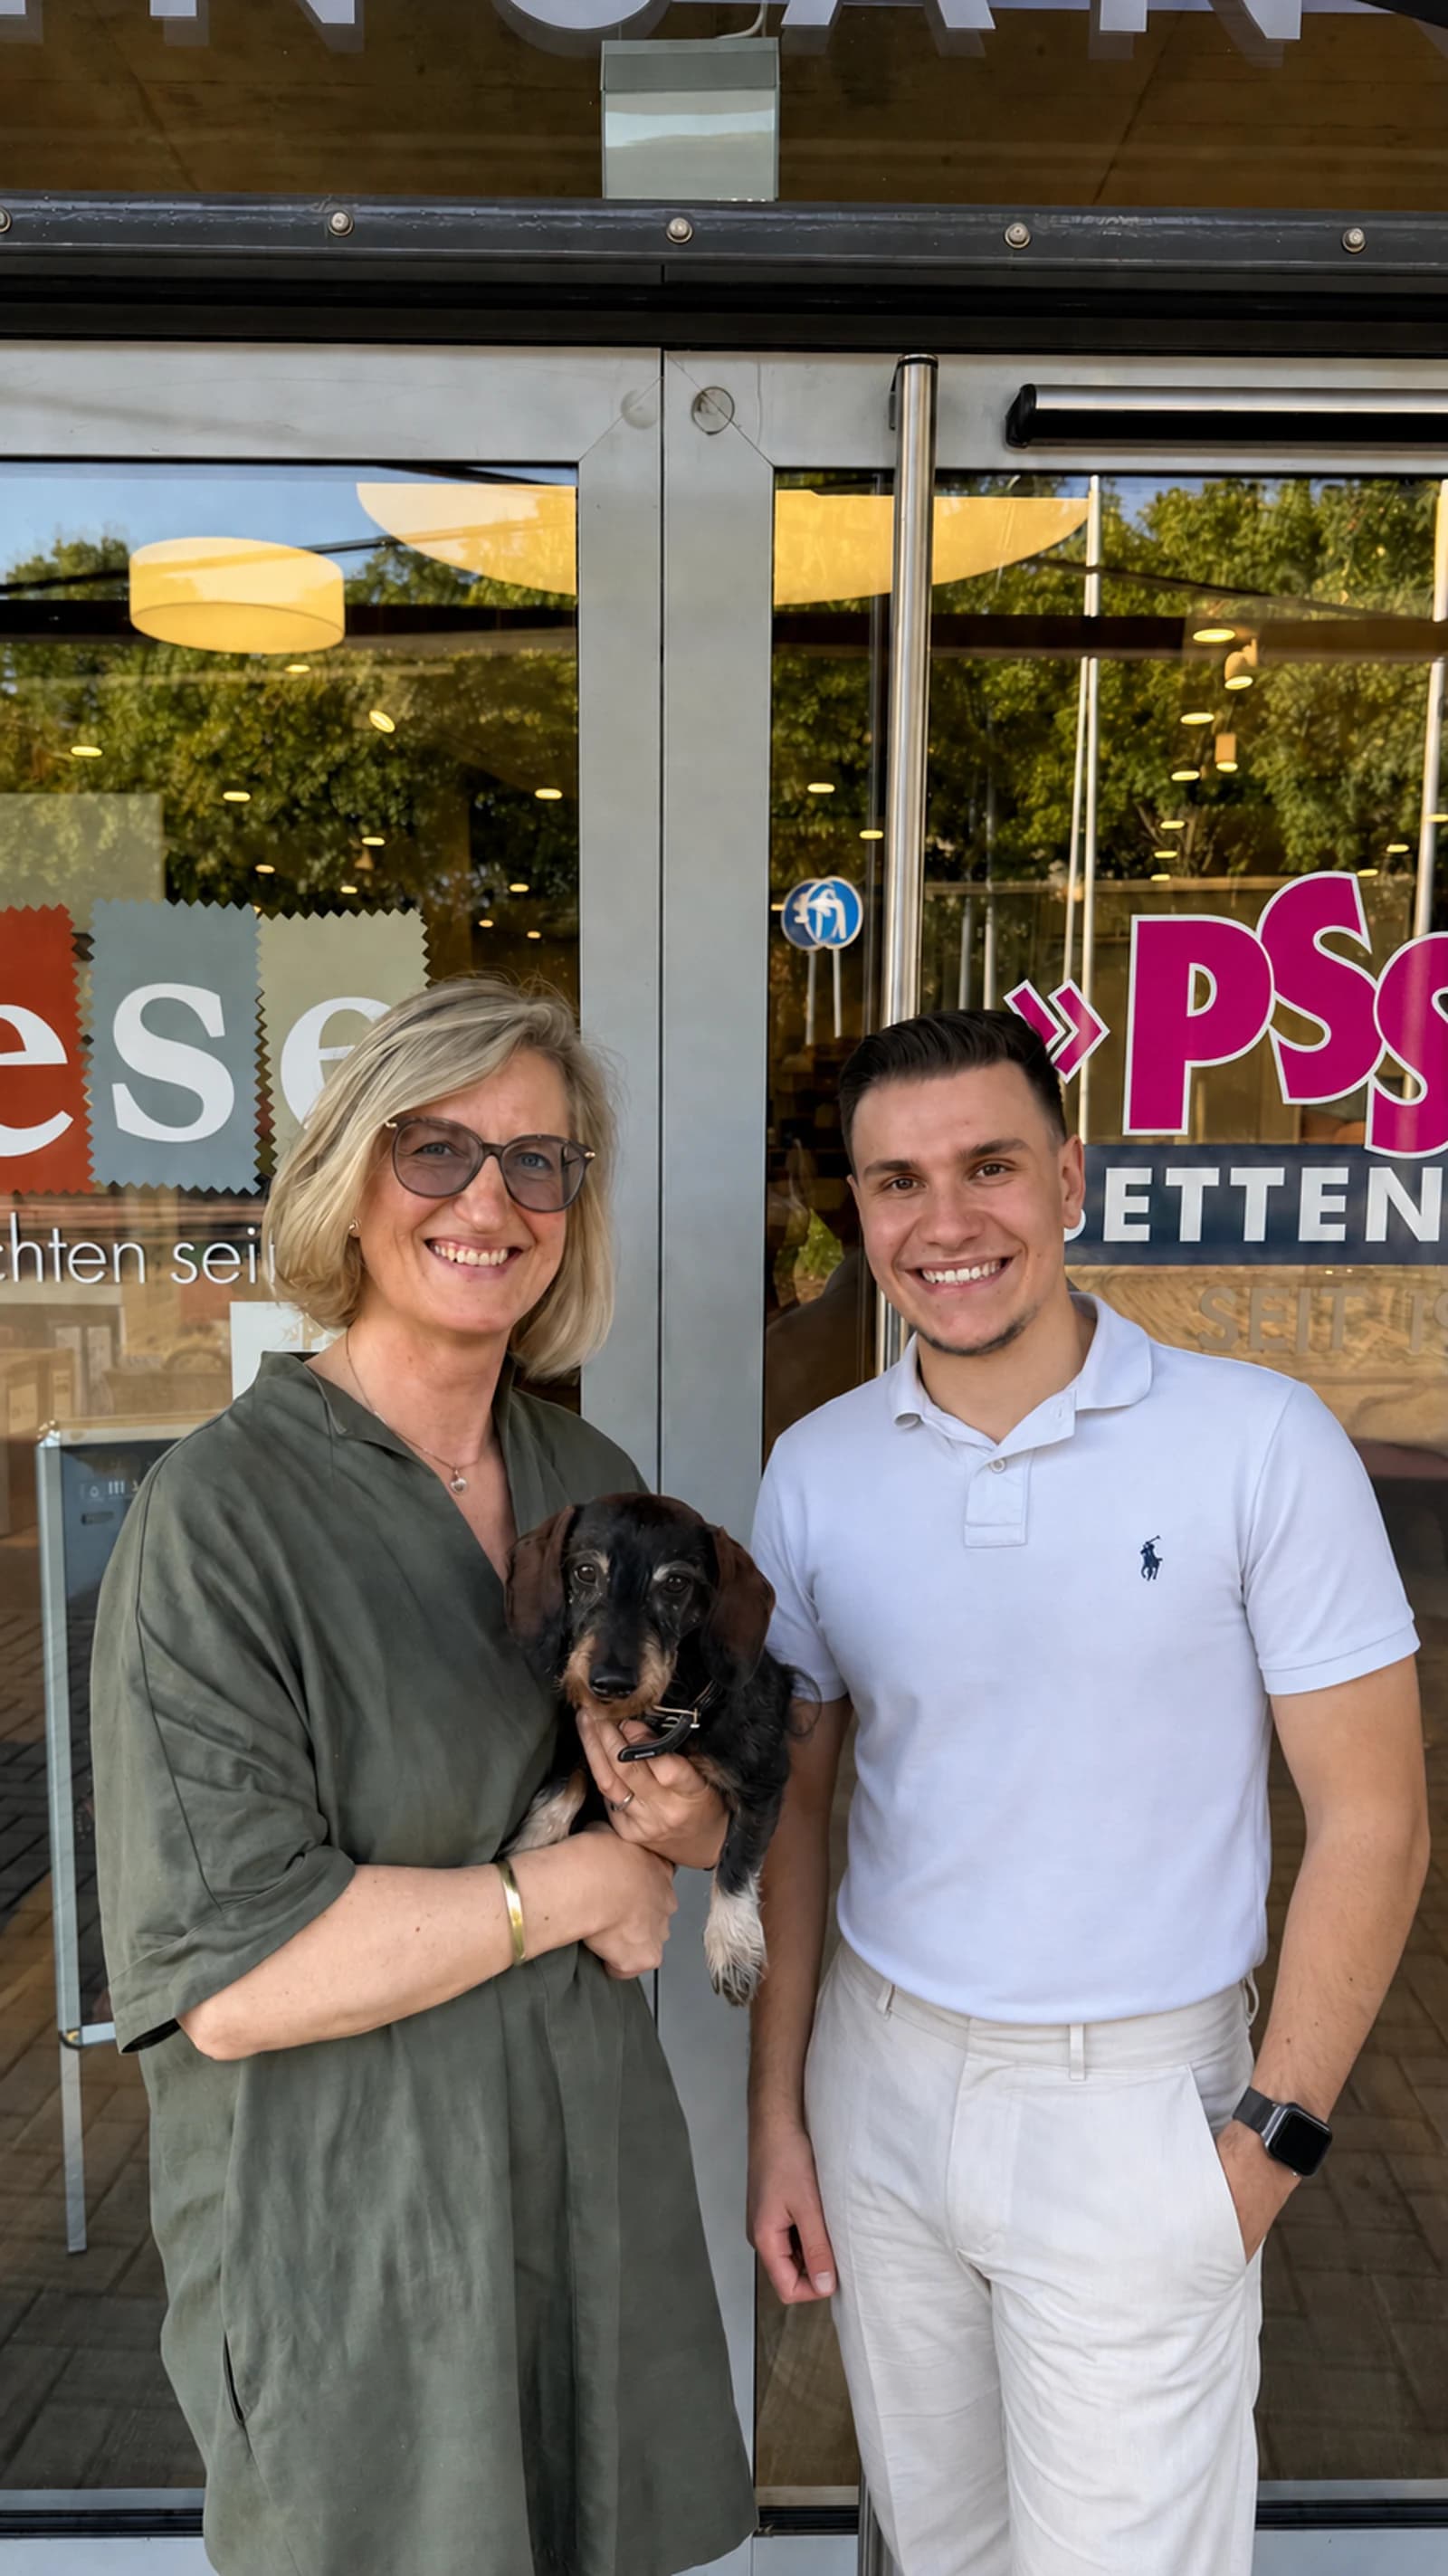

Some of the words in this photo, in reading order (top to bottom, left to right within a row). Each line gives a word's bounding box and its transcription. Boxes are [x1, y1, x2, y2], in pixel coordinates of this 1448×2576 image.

[1064, 1167, 1443, 1242] ETTEN
[0, 1212, 145, 1283] hten
[170, 1227, 275, 1283] sei
[1198, 1286, 1365, 1354] SEIT
